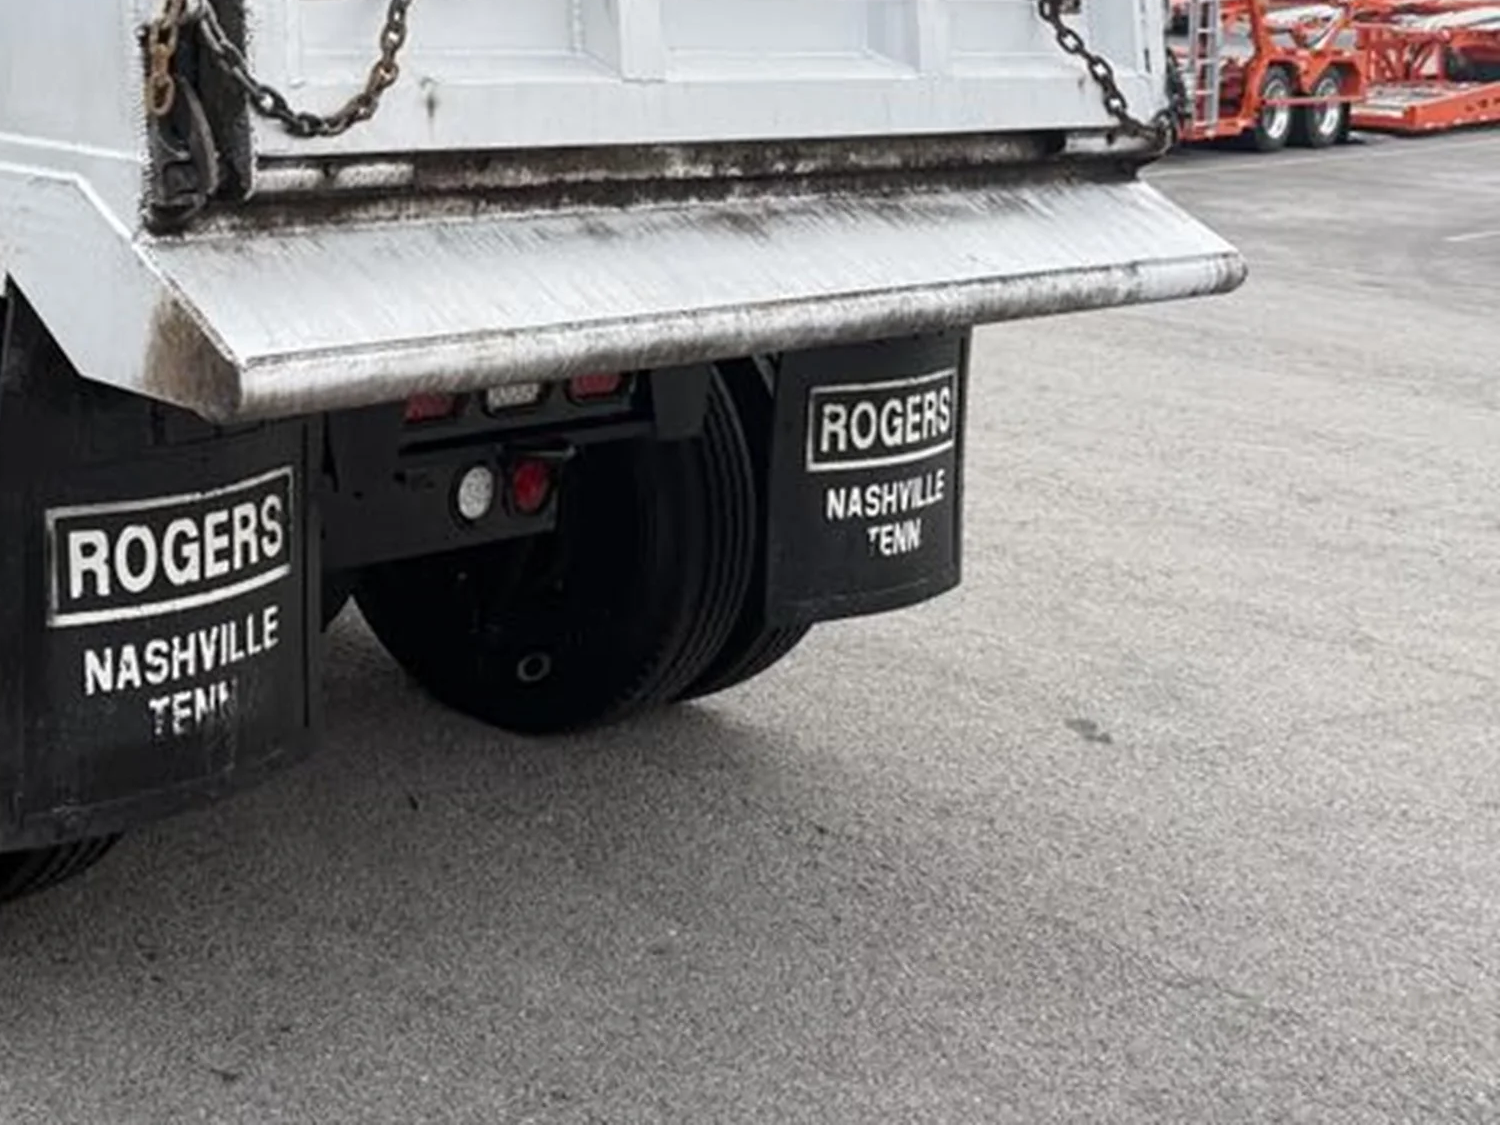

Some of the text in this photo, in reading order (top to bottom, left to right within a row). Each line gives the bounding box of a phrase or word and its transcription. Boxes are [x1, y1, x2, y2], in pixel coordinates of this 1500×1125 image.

[820, 385, 951, 453] ROGERS
[827, 469, 945, 520] NASHVILLE
[67, 494, 283, 599] ROGERS
[83, 605, 280, 695] NASHVILLE
